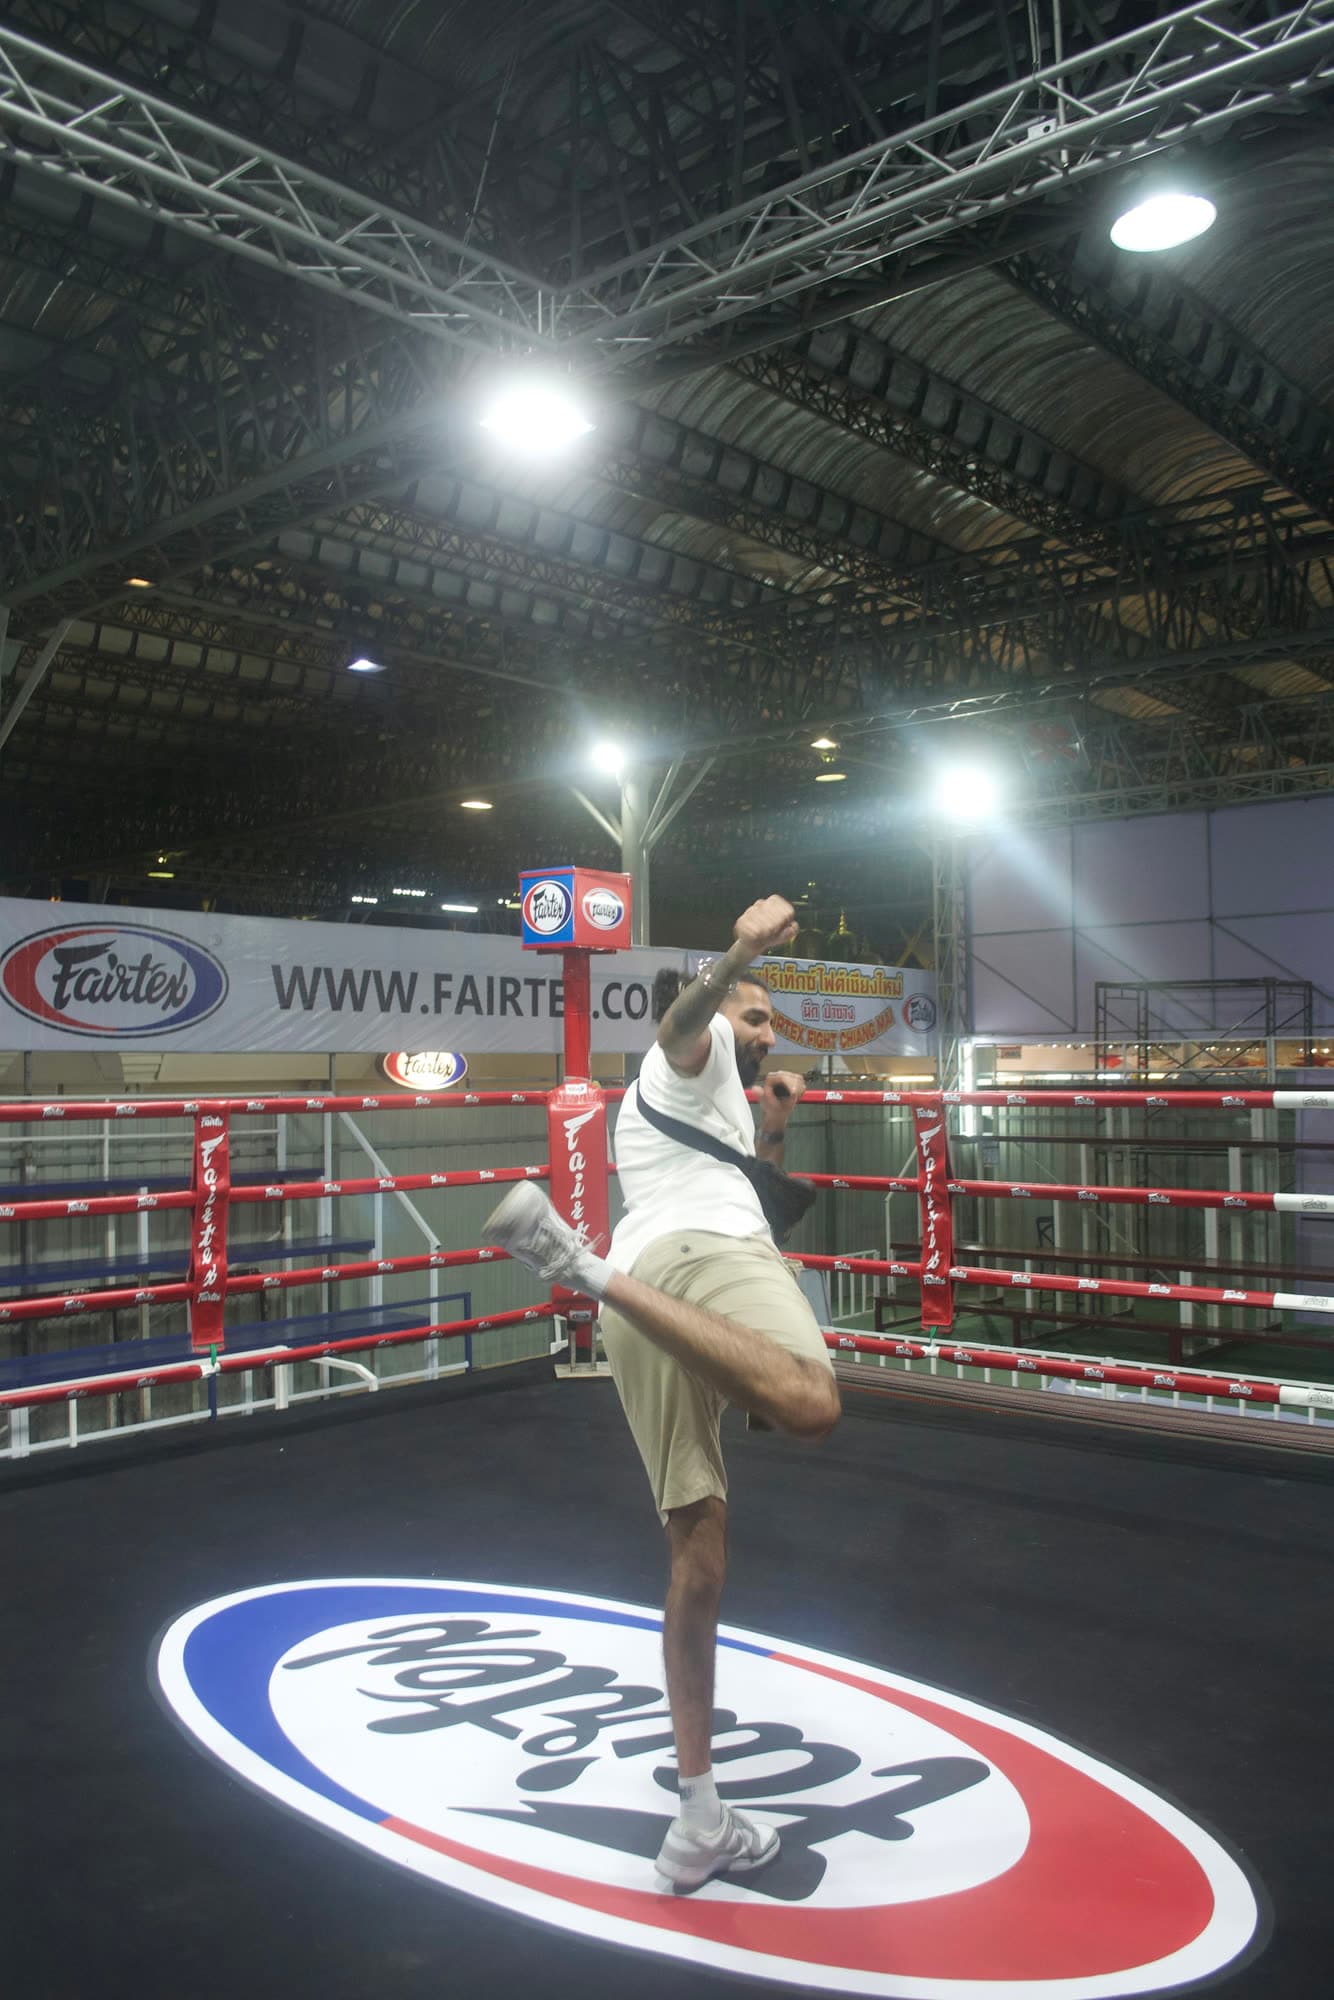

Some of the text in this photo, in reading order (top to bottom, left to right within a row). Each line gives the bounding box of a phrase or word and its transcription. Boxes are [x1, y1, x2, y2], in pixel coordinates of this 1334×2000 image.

[533, 888, 563, 923] Fairtex
[53, 940, 188, 1010] Fairtex
[272, 964, 659, 1023] WWW.FAIRTE.CO
[807, 1029, 837, 1051] FIGHT
[840, 1023, 876, 1049] CHIANG
[199, 1132, 226, 1287] Fairtex
[282, 1619, 990, 1901] Fairtex
